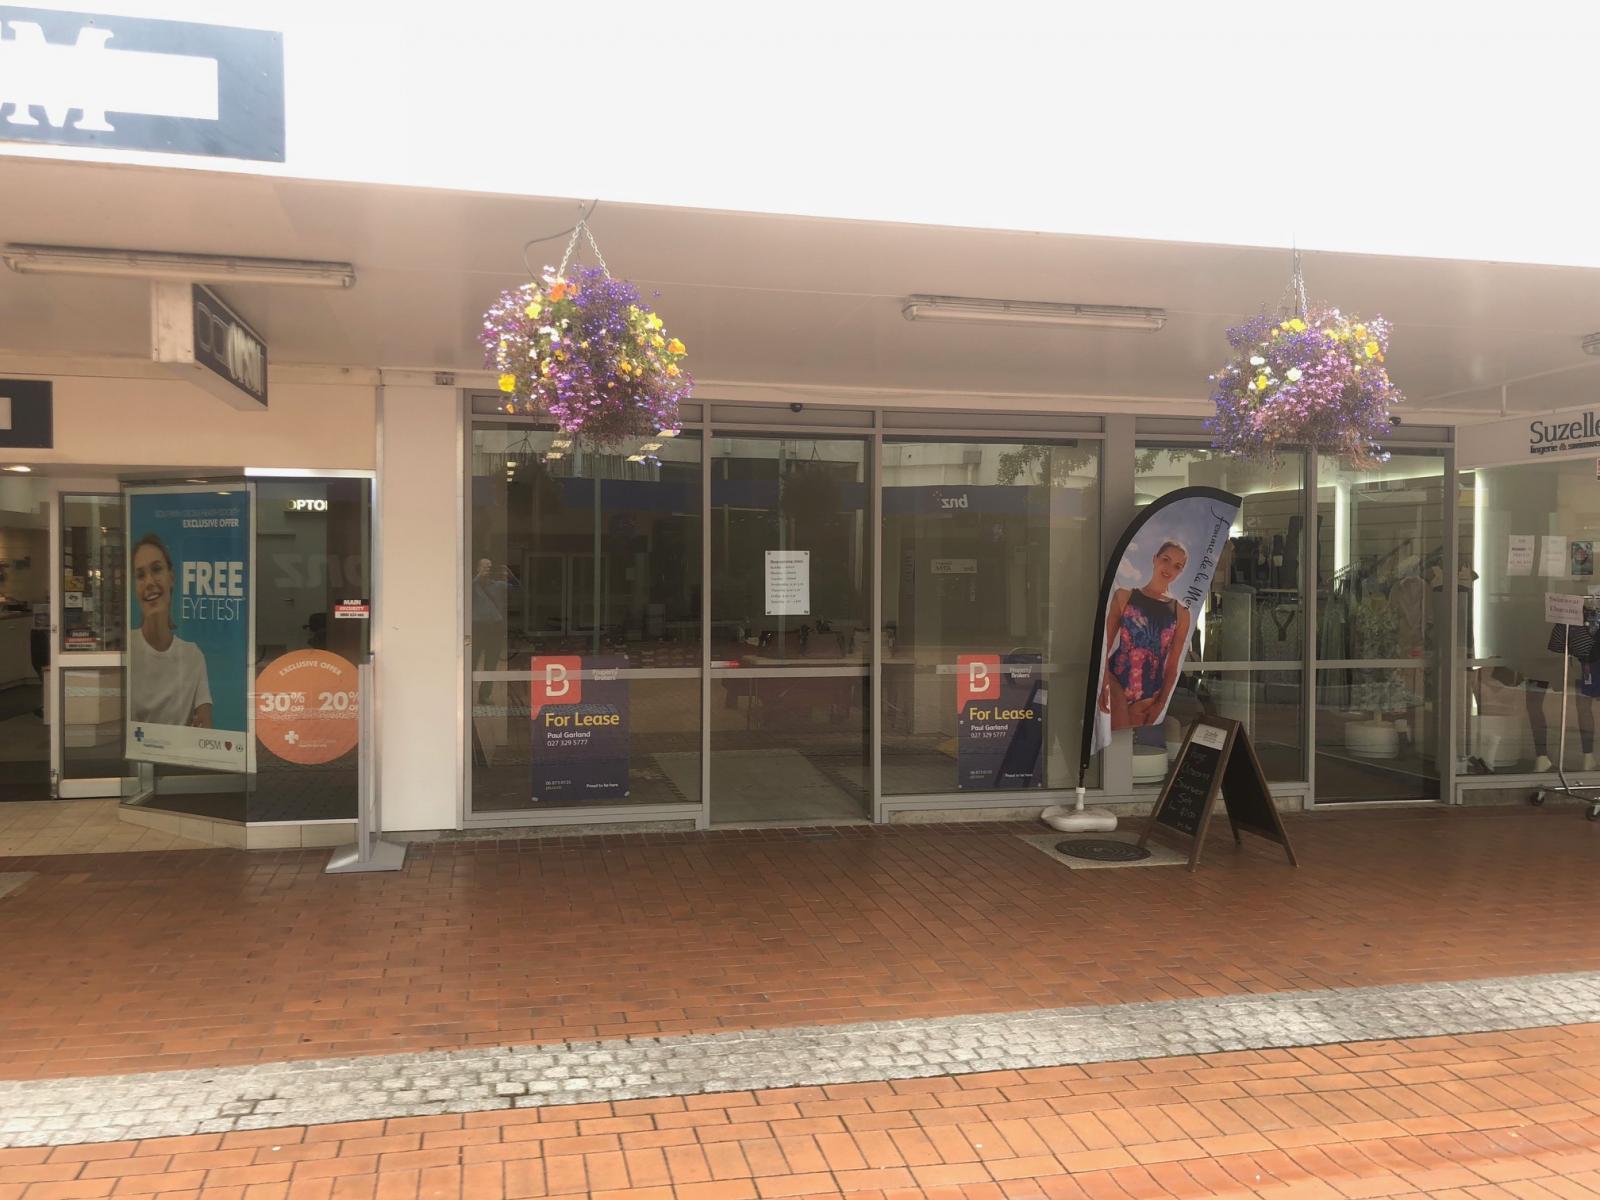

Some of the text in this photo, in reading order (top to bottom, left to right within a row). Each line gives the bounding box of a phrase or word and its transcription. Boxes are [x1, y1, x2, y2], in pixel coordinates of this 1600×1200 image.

[288, 499, 328, 511] OPTO
[183, 518, 239, 528] EXCLUSIVE OFFER
[182, 561, 243, 596] FREE
[279, 661, 342, 676] EXCLUSIVE OFFER
[546, 664, 569, 696] B
[970, 663, 990, 692] B
[545, 712, 620, 727] For Lease
[970, 707, 1033, 720] For Lease
[564, 731, 591, 739] Garland
